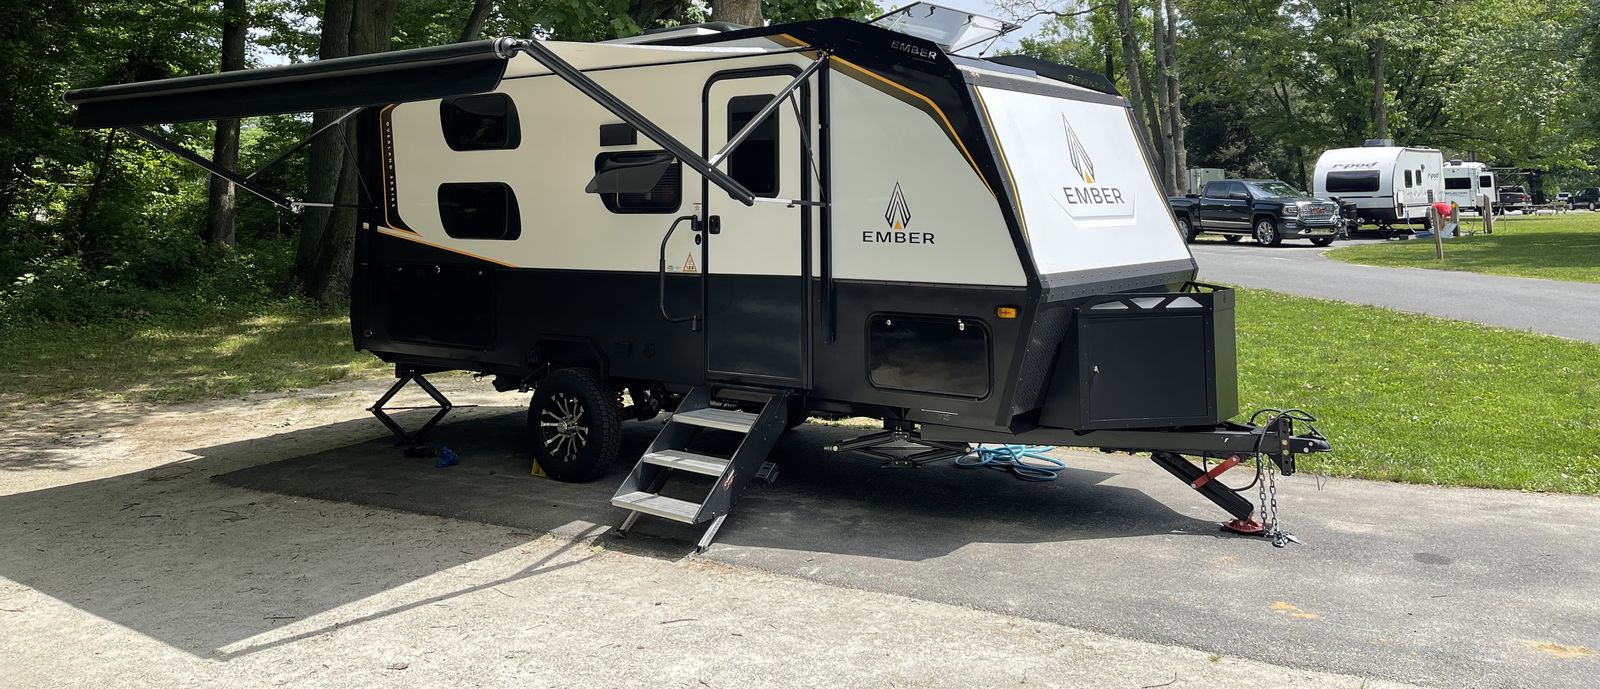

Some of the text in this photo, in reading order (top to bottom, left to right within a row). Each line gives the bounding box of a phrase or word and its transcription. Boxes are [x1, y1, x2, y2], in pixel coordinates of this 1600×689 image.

[890, 40, 937, 60] EMBER
[1062, 186, 1125, 205] EMBER
[862, 231, 935, 245] EMBER
